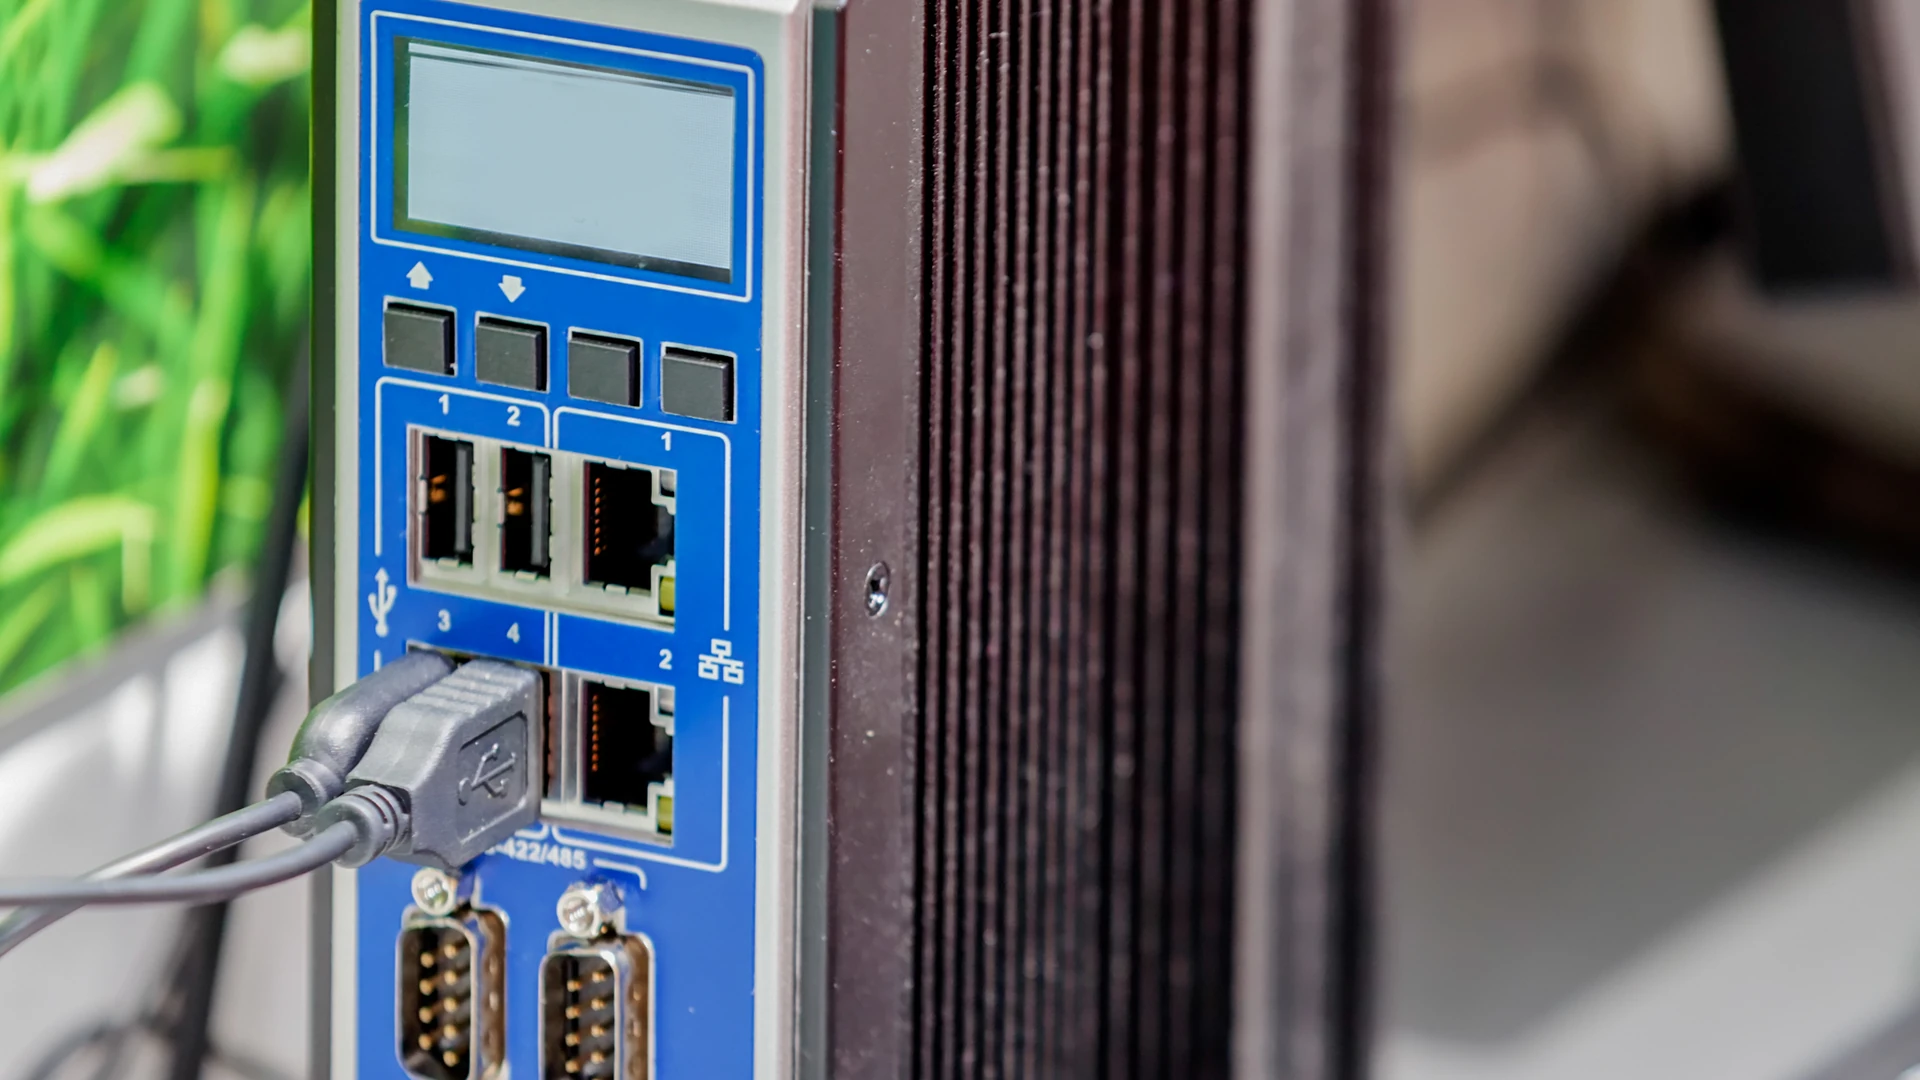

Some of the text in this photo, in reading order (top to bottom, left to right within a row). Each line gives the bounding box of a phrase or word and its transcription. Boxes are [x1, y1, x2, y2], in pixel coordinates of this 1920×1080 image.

[438, 394, 521, 426] 1 2
[661, 431, 672, 451] 1
[438, 610, 520, 643] 3 4
[659, 649, 672, 670] 2
